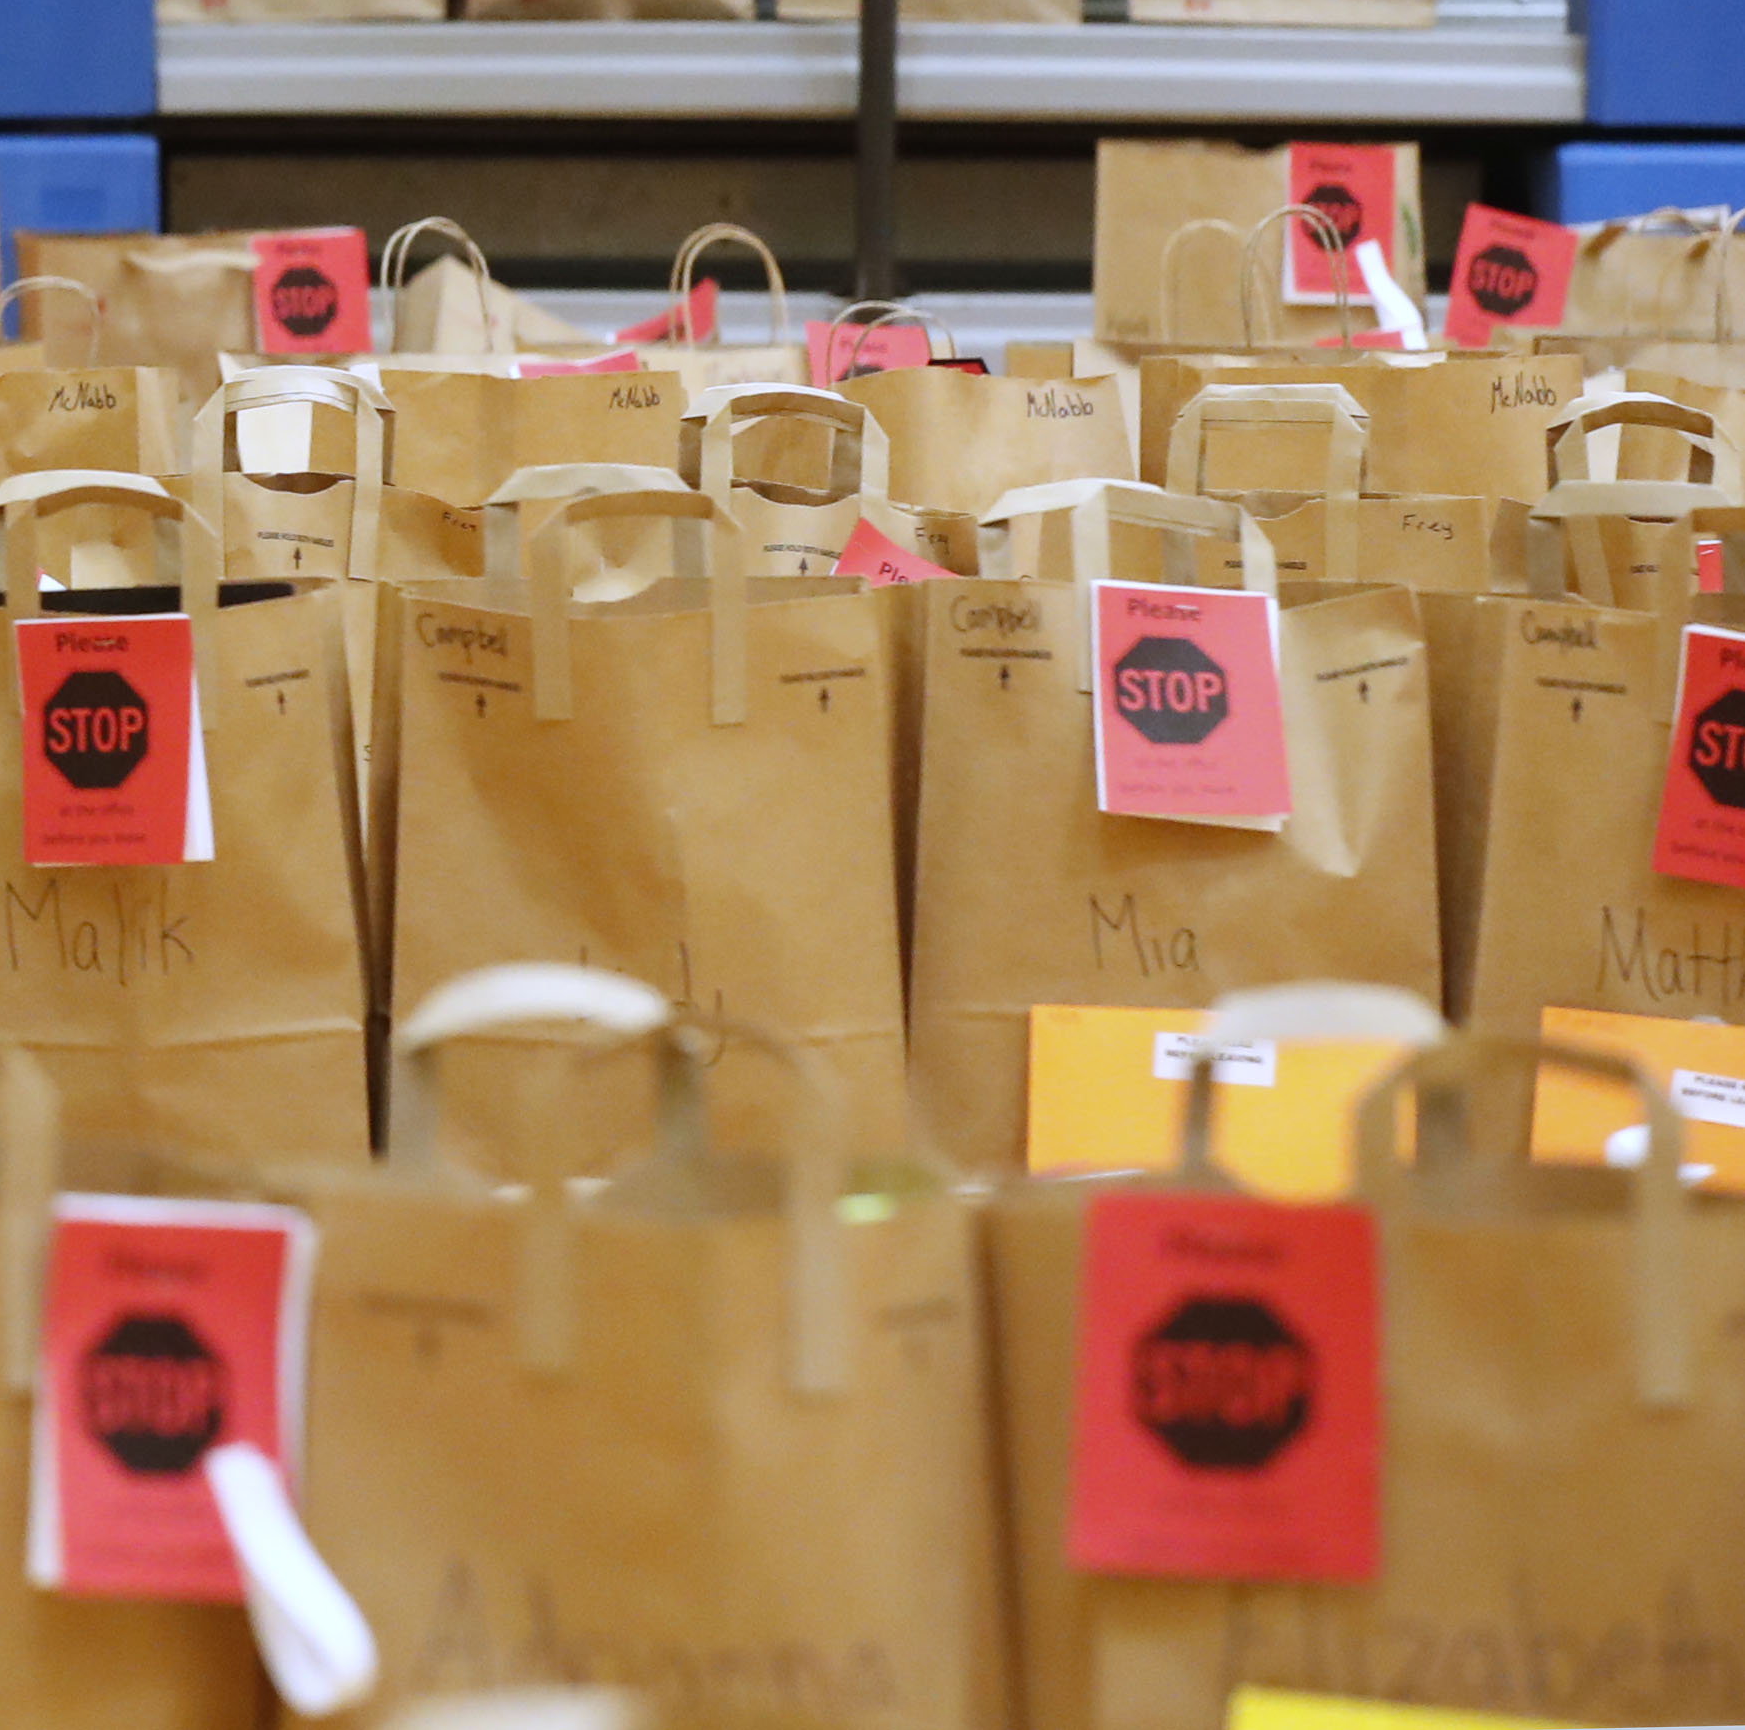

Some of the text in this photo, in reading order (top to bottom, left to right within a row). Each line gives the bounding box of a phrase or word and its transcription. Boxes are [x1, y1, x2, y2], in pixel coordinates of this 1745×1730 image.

[47, 383, 119, 414] McNabb
[1126, 597, 1204, 623] Please
[54, 629, 130, 656] Please
[1115, 667, 1224, 716] STOP
[46, 704, 145, 756] STOP
[1694, 718, 1745, 770] ST
[4, 879, 197, 988] Malik
[1088, 891, 1201, 980] Mia
